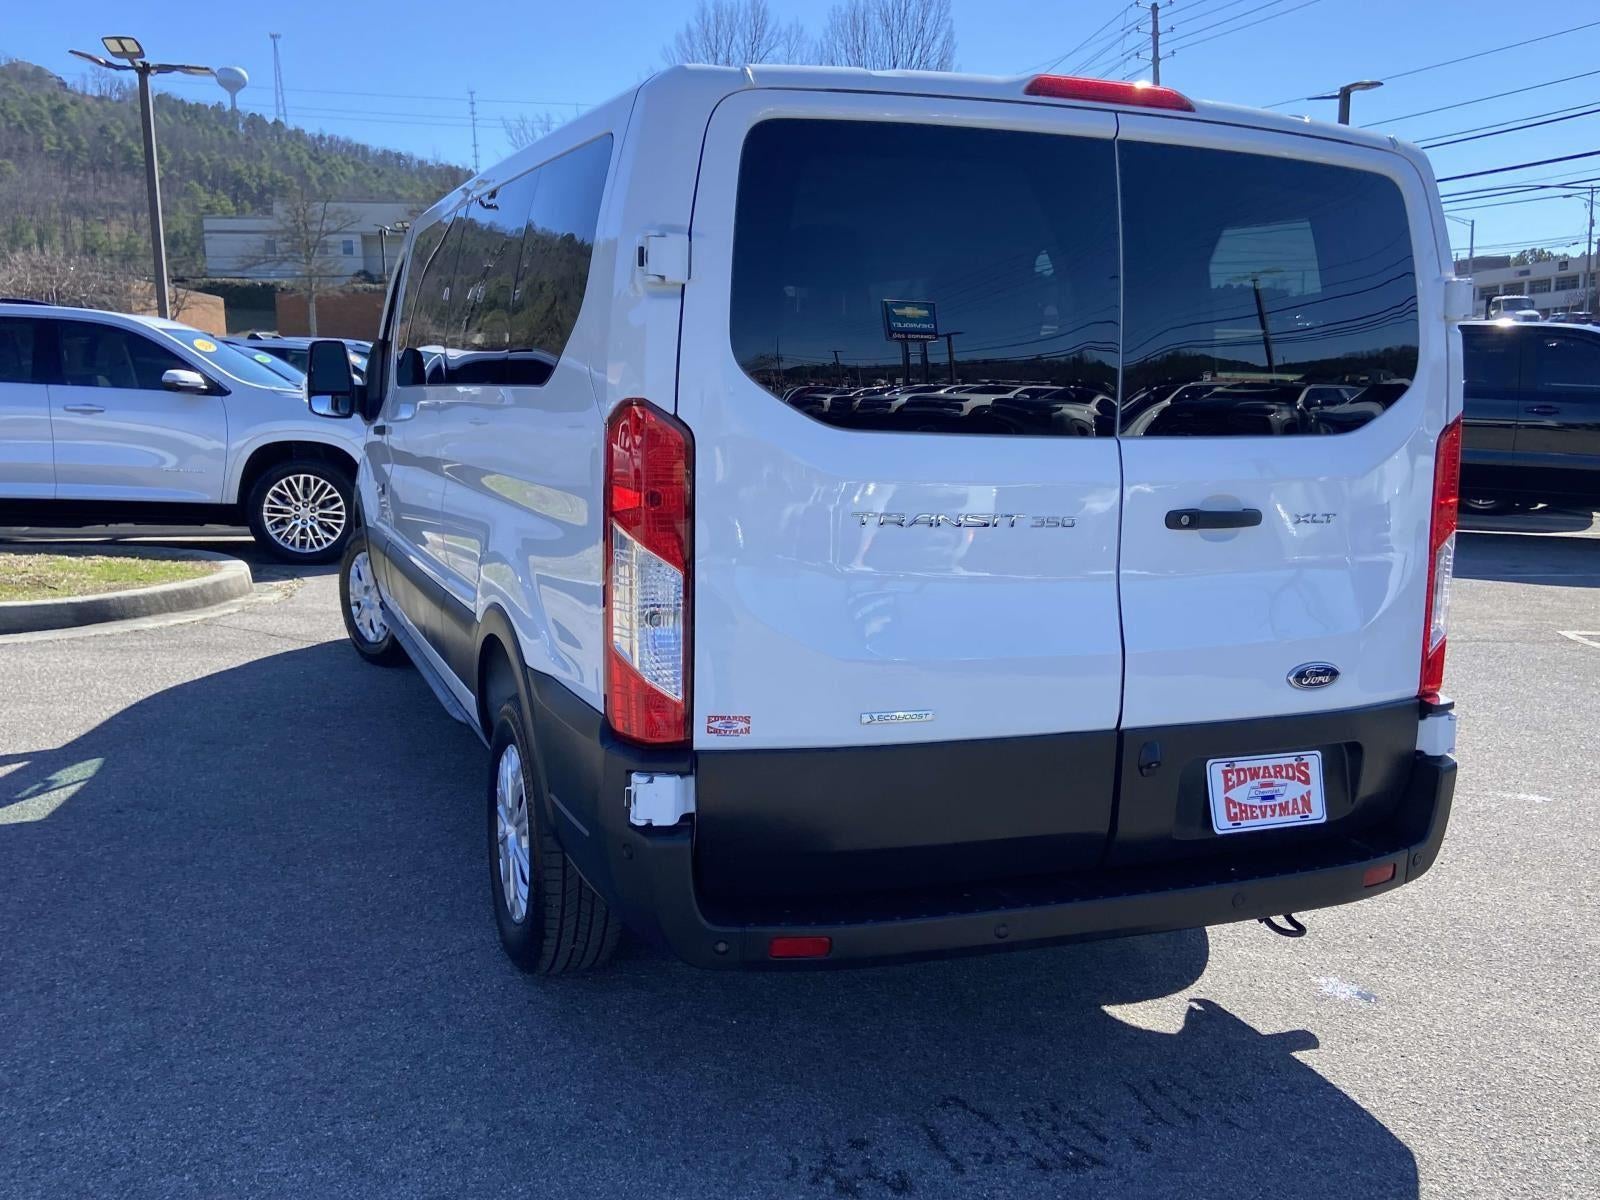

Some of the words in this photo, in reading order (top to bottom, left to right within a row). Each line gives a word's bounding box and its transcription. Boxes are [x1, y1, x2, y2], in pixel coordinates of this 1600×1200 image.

[851, 511, 1026, 528] TRANSIT
[1030, 516, 1080, 528] 350
[1293, 513, 1337, 524] XLT
[1301, 669, 1332, 684] Ford
[707, 715, 751, 724] EDWARDS
[706, 725, 751, 735] CHEVYMAN
[1221, 761, 1311, 795] EDWARDS
[1224, 789, 1313, 822] CHEVYMAN
